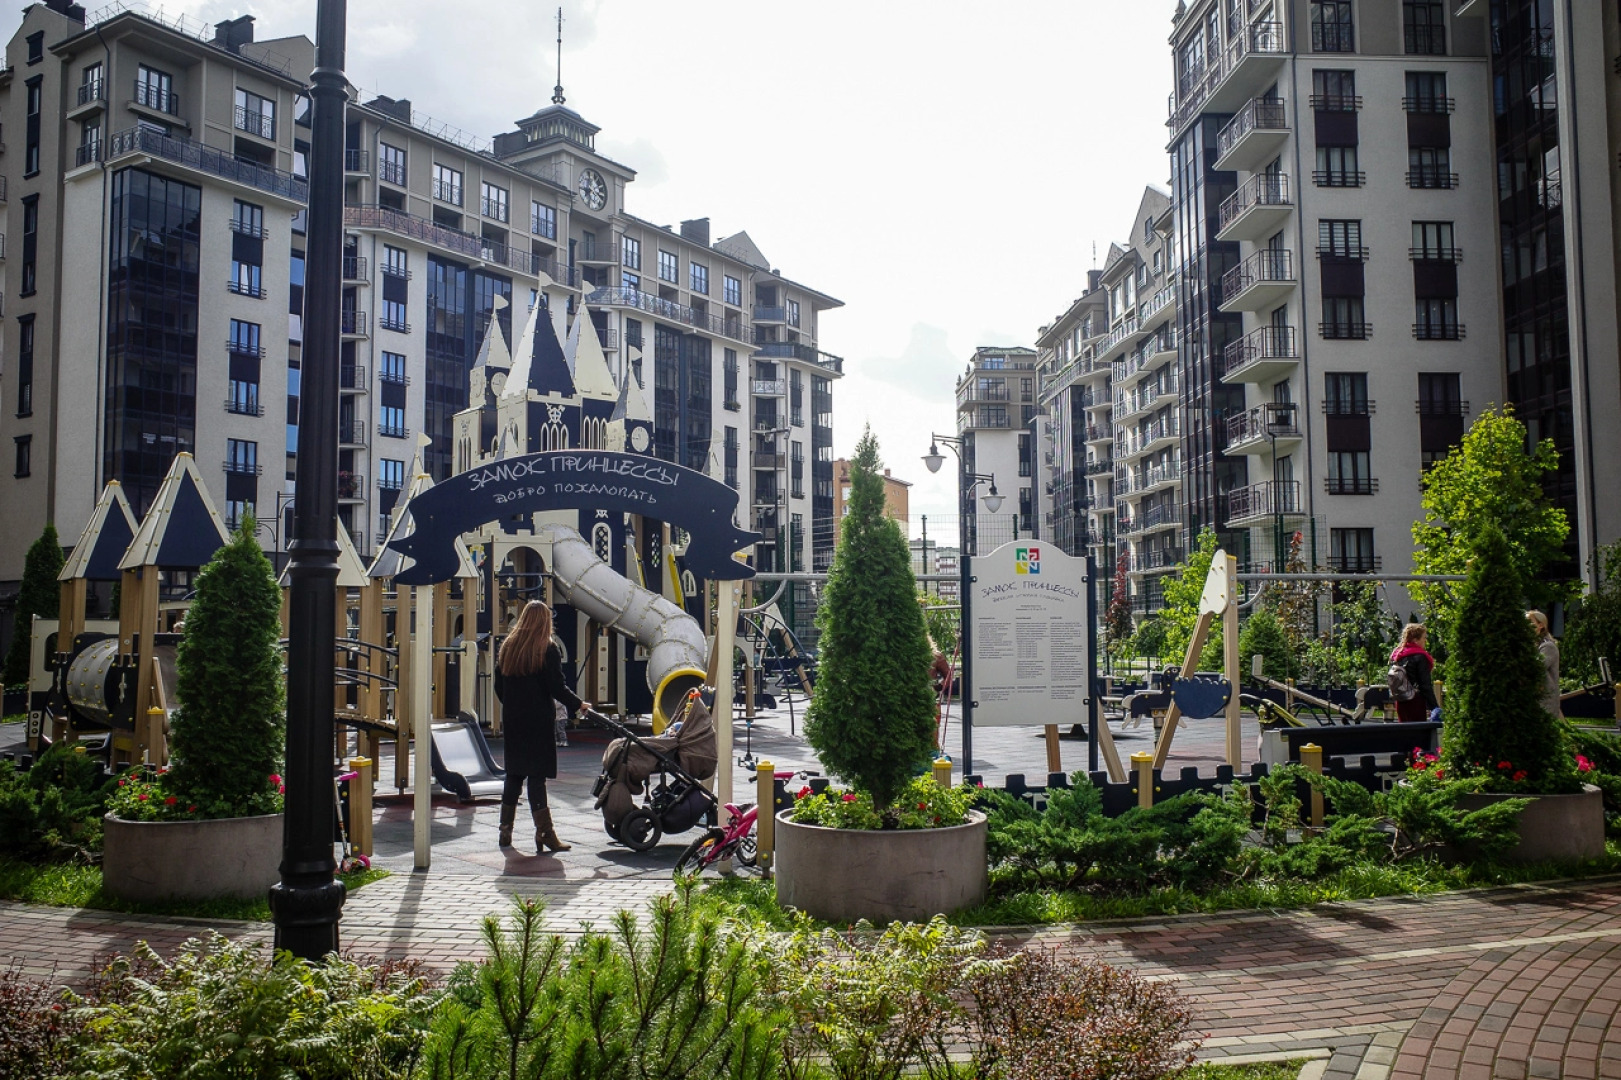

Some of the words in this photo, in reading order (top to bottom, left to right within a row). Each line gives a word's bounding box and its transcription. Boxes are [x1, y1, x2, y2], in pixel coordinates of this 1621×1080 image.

[468, 458, 546, 491] ЗАМОК
[551, 456, 679, 486] ПРИНЦЕССЫ
[492, 485, 546, 504] ДОБРО
[554, 483, 657, 504] ПОЖАЛОВАТЬ
